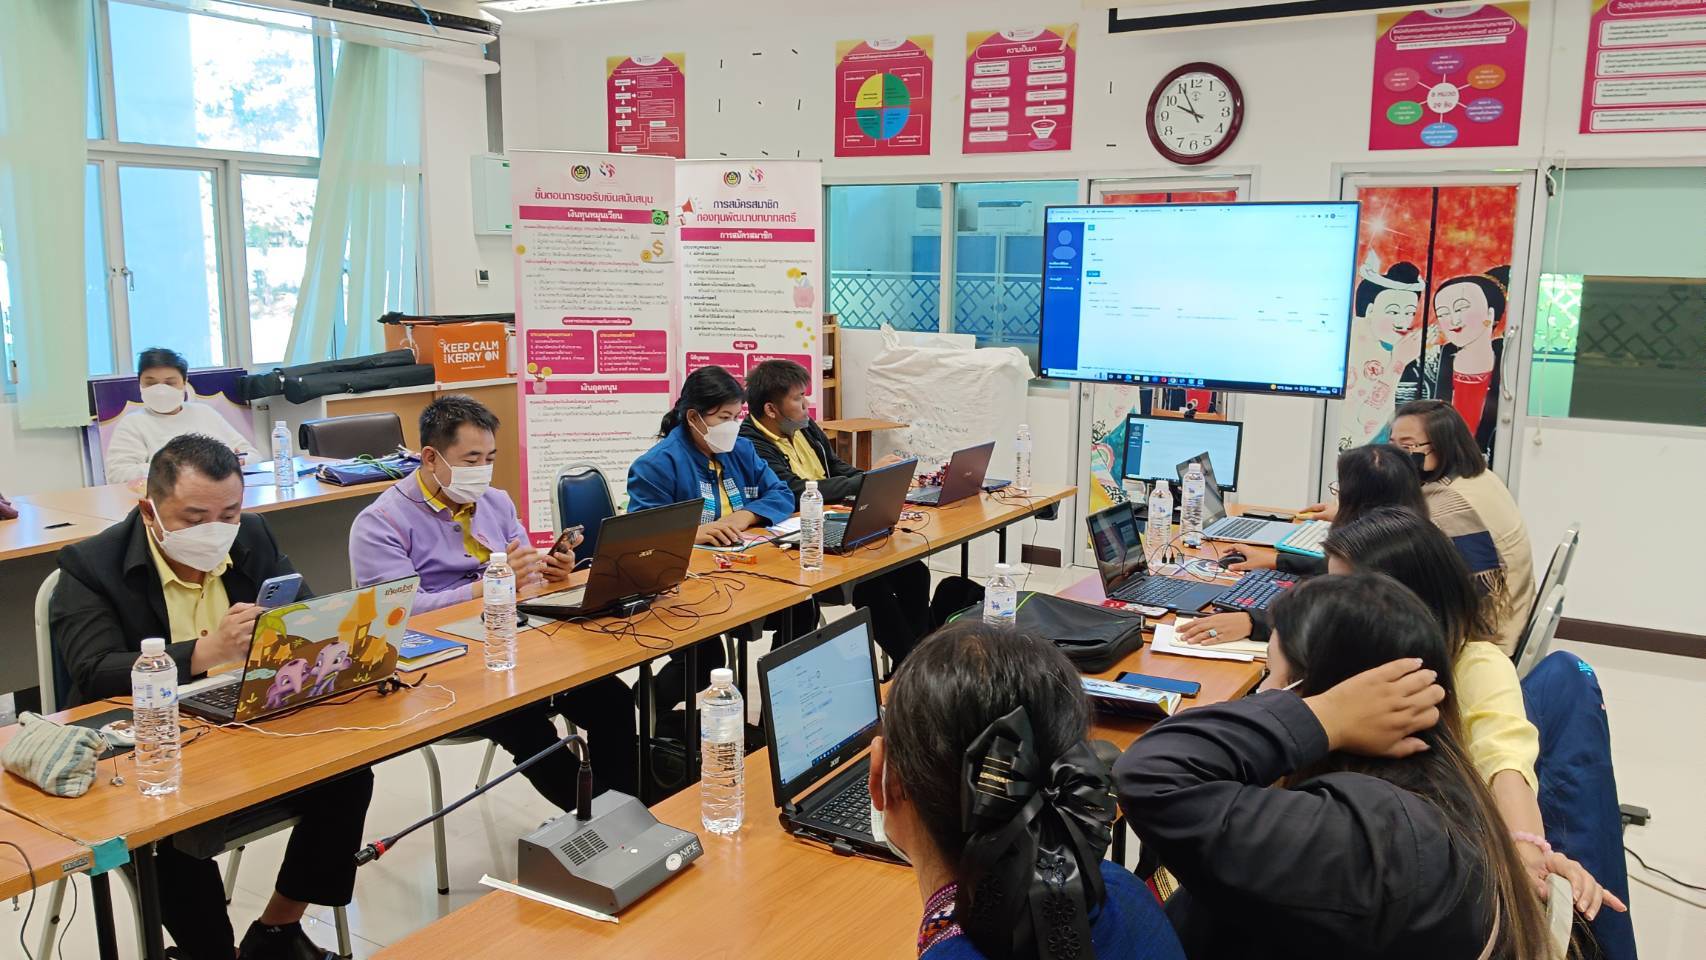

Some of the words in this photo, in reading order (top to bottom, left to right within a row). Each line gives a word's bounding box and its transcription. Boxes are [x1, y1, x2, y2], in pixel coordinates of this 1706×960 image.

[1007, 45, 1037, 53] ความเป็นมา
[1190, 79, 1203, 88] 12
[1209, 81, 1213, 92] 1
[1167, 96, 1177, 106] 10
[1218, 91, 1226, 102] 2
[1161, 111, 1169, 122] 9
[1221, 107, 1230, 117] 3
[1164, 125, 1173, 136] 8
[1215, 122, 1223, 133] 4
[1176, 137, 1184, 148] 7
[1189, 140, 1198, 150] 6
[1203, 135, 1212, 146] 5
[535, 187, 654, 206] ขั้นตอนการขอรับเงินสนับสนุน
[713, 198, 779, 209] การสมัครสมาชิก
[567, 209, 623, 221] เงินทุนหมุนเวียน
[697, 211, 797, 224] กองทุนพัฒนาบทบาทสตรี
[719, 230, 773, 239] การสมัครสมาชิก
[443, 343, 470, 353] KEEP
[473, 341, 499, 351] CALM
[448, 352, 482, 363] KERRY
[681, 841, 699, 858] NPE
